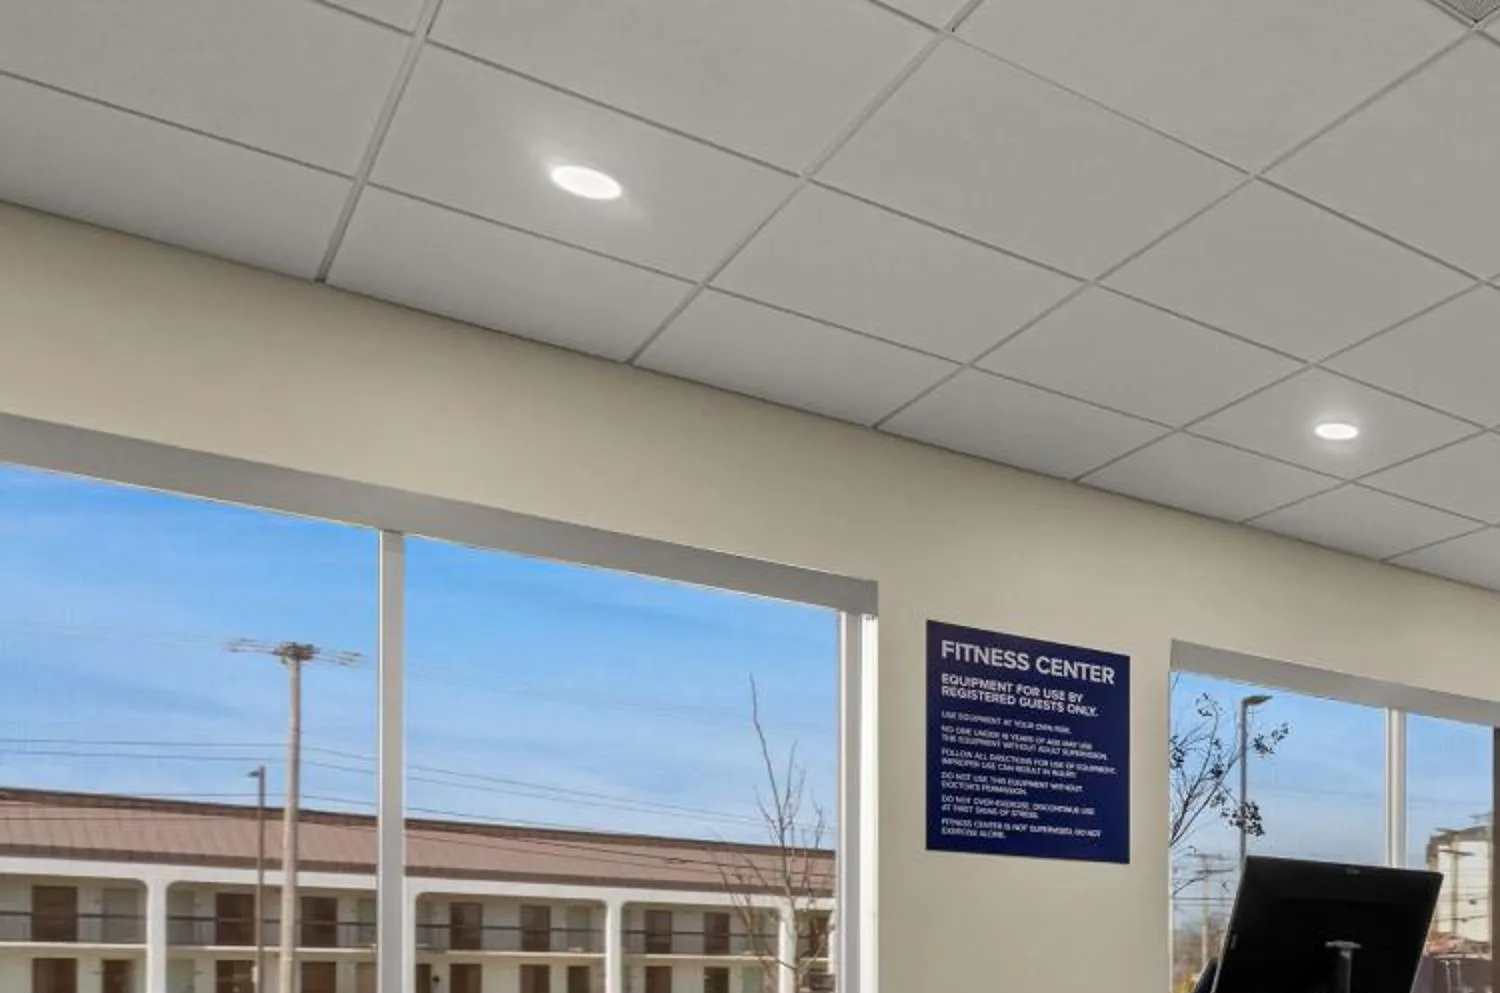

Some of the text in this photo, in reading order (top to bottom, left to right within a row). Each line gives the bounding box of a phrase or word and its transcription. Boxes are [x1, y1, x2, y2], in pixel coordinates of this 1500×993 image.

[942, 639, 1115, 685] FITNESS CENTER
[942, 673, 1084, 703] EQUIPMENT FOR USE BY
[942, 686, 1099, 717] REGISTERED GUESTS ONLY.
[942, 710, 957, 719] USE
[957, 711, 1002, 725] EQUIPMENT
[1013, 719, 1035, 729] YOUR
[1035, 723, 1053, 731] OWN
[942, 733, 957, 742] THE
[957, 735, 1001, 747] EQUIPMENT
[1002, 741, 1036, 752] WITHOUT
[955, 726, 972, 735] ONE
[973, 728, 1000, 738] UNDER
[1010, 733, 1034, 742] YEARS
[942, 747, 973, 758] FOLLOW
[989, 753, 1033, 765] DIRECTIONS
[1033, 758, 1049, 767] FOR
[942, 757, 980, 768] IMPROPER
[981, 761, 996, 770] USE
[997, 763, 1014, 771] CAN
[1015, 765, 1041, 775] RESULT
[955, 772, 971, 781] NOT
[972, 775, 988, 783] USE
[989, 775, 1007, 785] THIS
[1007, 777, 1049, 789] EQUIPMENT
[952, 804, 973, 813] FIRST
[955, 795, 971, 804] NOT
[942, 818, 973, 827] FITNESS
[973, 820, 1003, 829] CENTER
[1012, 823, 1029, 831] NOT
[942, 827, 978, 836] EXERCISE
